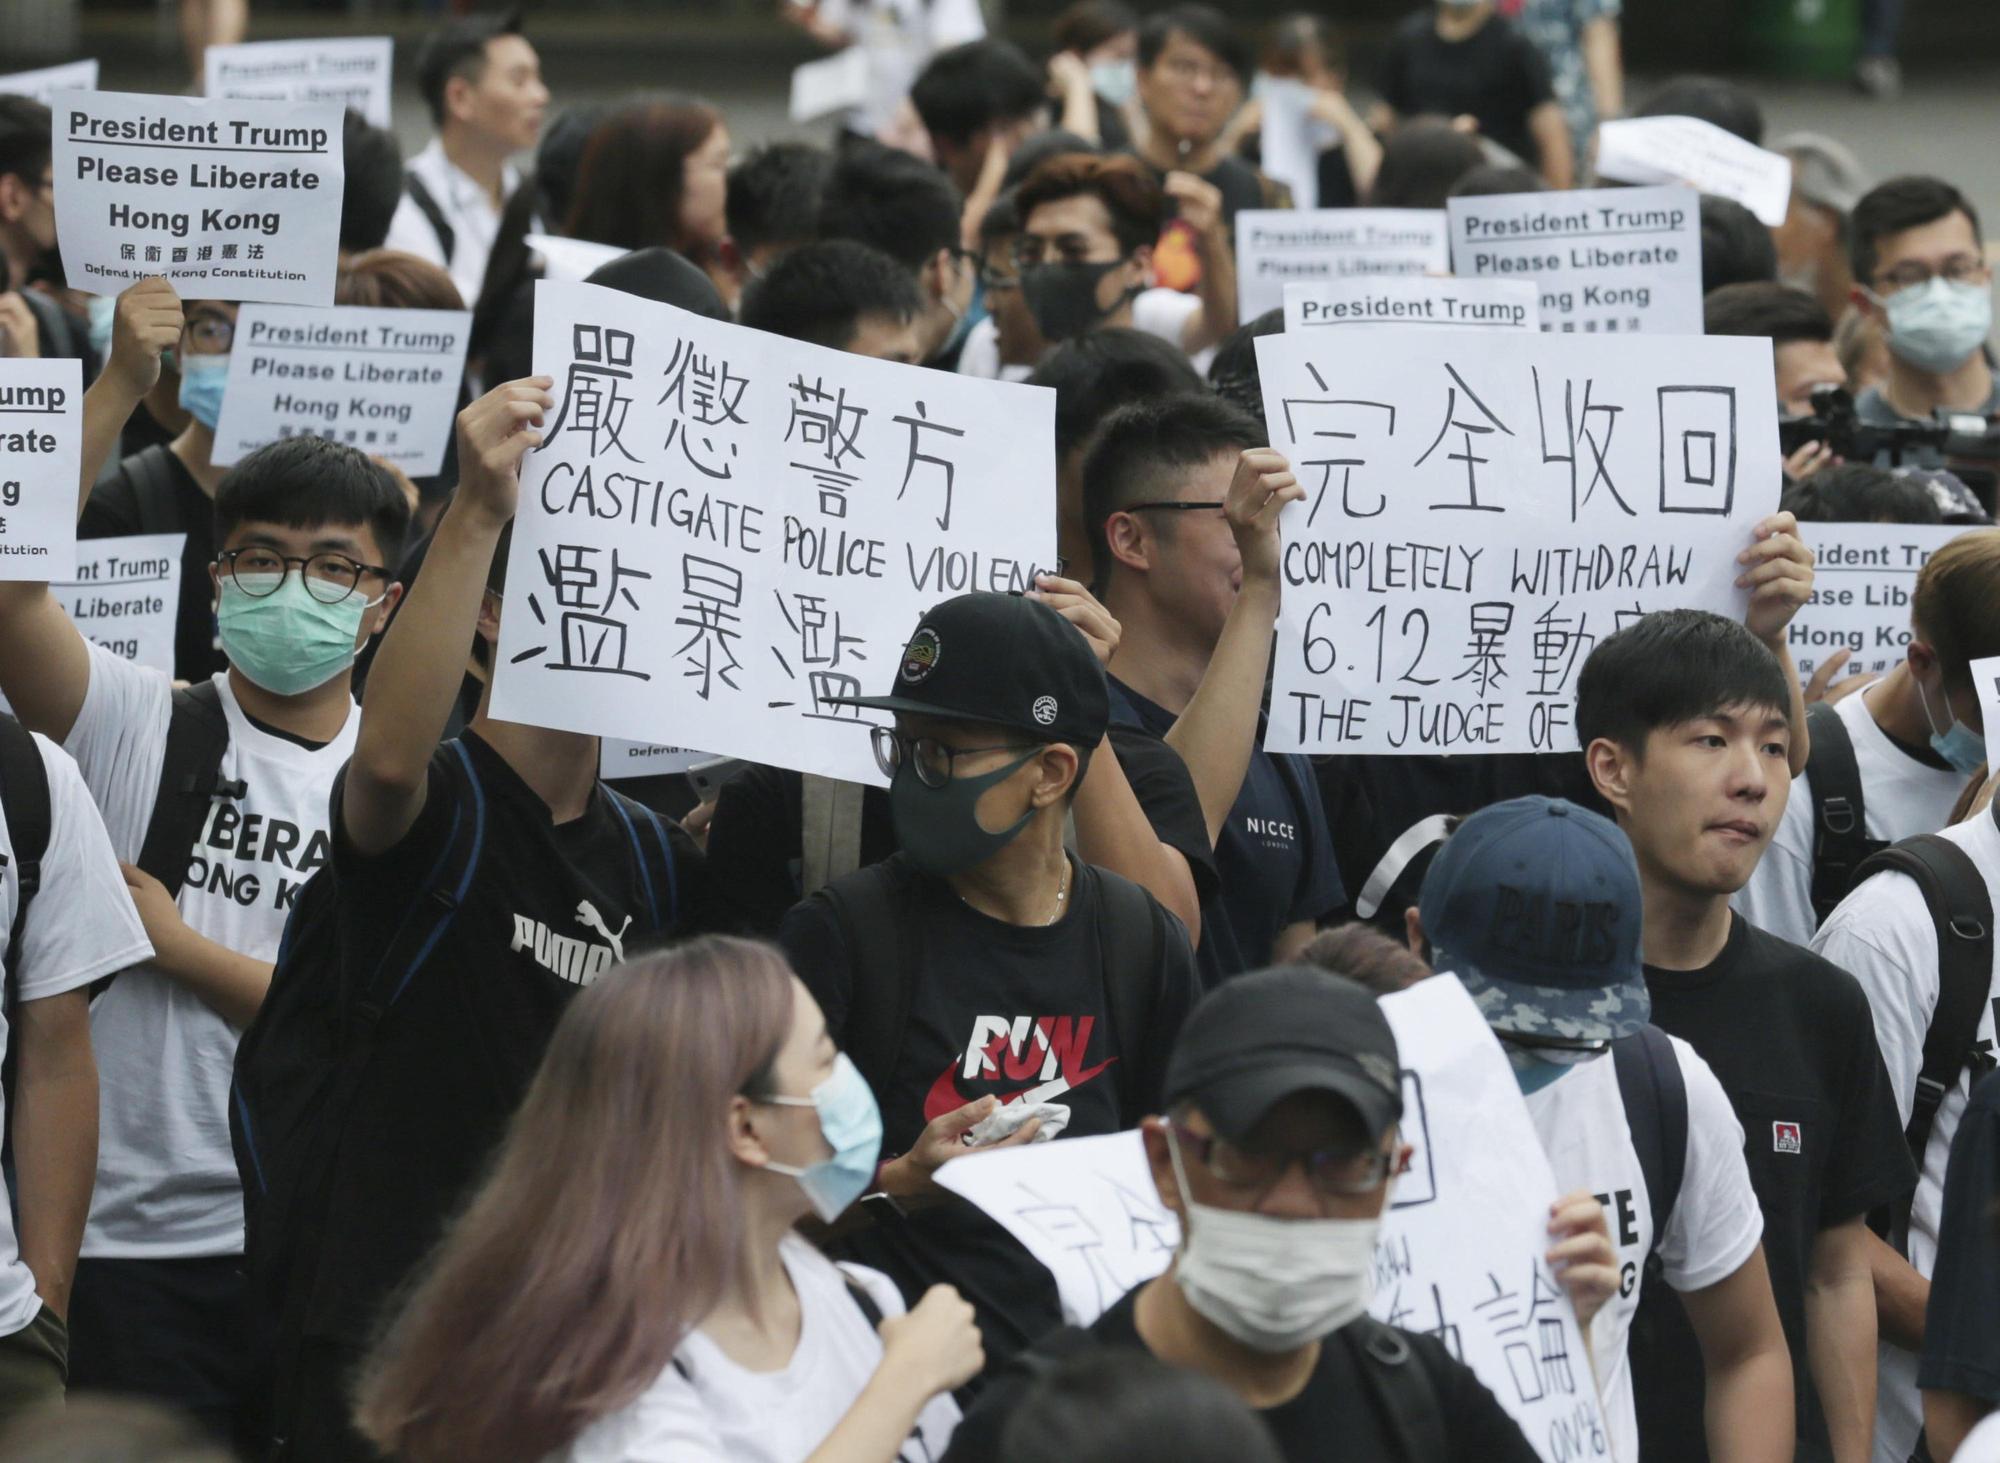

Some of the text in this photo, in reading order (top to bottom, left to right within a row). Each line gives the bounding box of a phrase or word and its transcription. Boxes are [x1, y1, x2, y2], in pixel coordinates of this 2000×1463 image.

[69, 111, 327, 151] President Trump
[77, 156, 320, 191] Please Liberate
[109, 203, 280, 237] Hong Kong
[1465, 205, 1685, 237] President Trump
[85, 263, 130, 279] Defend
[171, 268, 207, 279] Kong
[212, 267, 307, 282] Constitution
[1475, 244, 1679, 275] Please Liberate
[1302, 297, 1525, 323] President Trump
[1583, 286, 1650, 309] Kong
[249, 321, 456, 352] President Trump
[251, 356, 443, 384] Please Liberate
[0, 385, 66, 413] ump
[273, 392, 413, 423] Hong Kong
[534, 323, 966, 531] 嚴懲警方
[1282, 361, 1737, 528] 完全收回
[540, 461, 1058, 593] CASTIGATE POLICE VIOLEN
[107, 557, 170, 580] Trump
[1284, 540, 1693, 596] COMPLETELY WITHDRAW
[74, 595, 163, 619] Liberate
[511, 543, 925, 727] 濫暴濫
[1789, 624, 1913, 652] Hong Ko
[1288, 691, 1570, 749] THE JUDGE OF
[628, 746, 679, 758] Defend
[1246, 817, 1295, 840] NICCE
[184, 856, 260, 907] ONG
[511, 913, 614, 987] PUMA
[962, 1015, 1096, 1082] RUN
